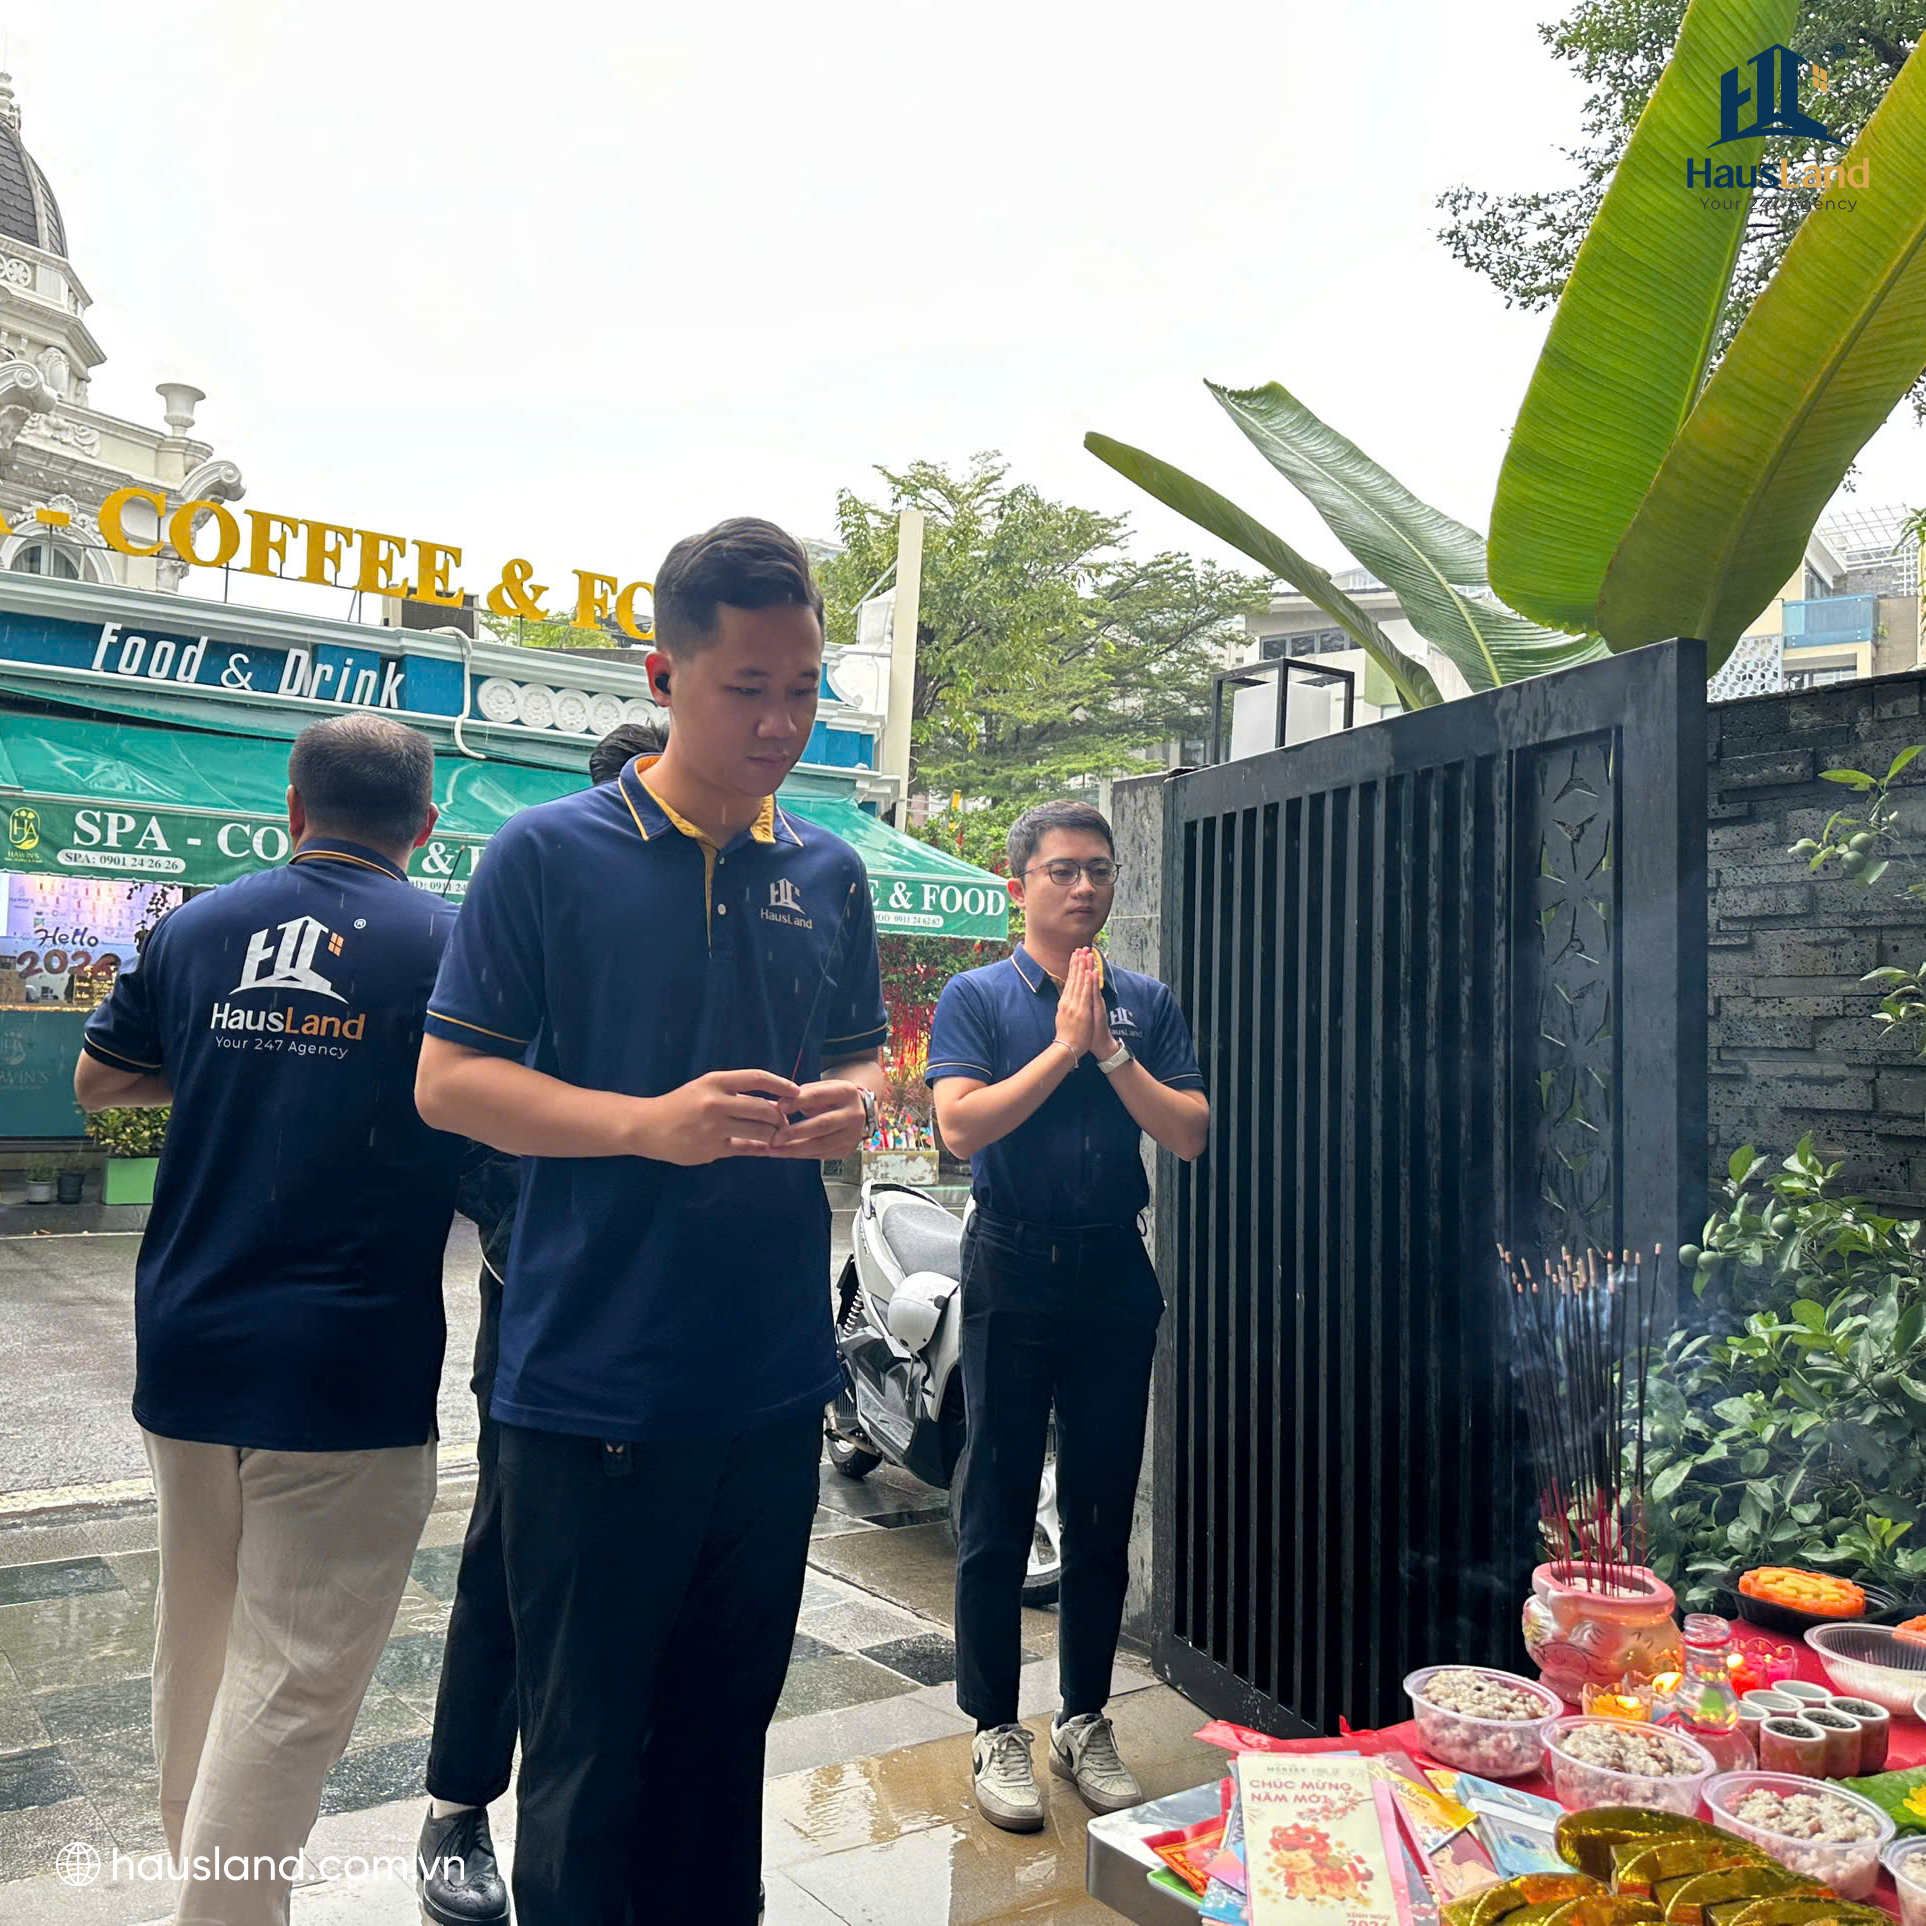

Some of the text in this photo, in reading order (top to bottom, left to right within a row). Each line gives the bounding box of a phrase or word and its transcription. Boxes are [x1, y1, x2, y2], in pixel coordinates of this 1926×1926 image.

[100, 487, 465, 608] COFFEE
[487, 558, 549, 621] &
[570, 568, 656, 641] FO
[92, 622, 405, 709] Food & Drink
[73, 809, 172, 852] SPA
[64, 852, 178, 870] SPA: 0901 24 26 26
[421, 841, 456, 875] &
[888, 881, 913, 910] &
[920, 883, 1006, 917] FOOD
[760, 907, 813, 929] HausLand
[34, 926, 99, 947] Hello
[210, 1002, 366, 1041] HausLand
[1110, 1027, 1142, 1039] ausLand
[215, 1036, 349, 1060] Your 247 Agency
